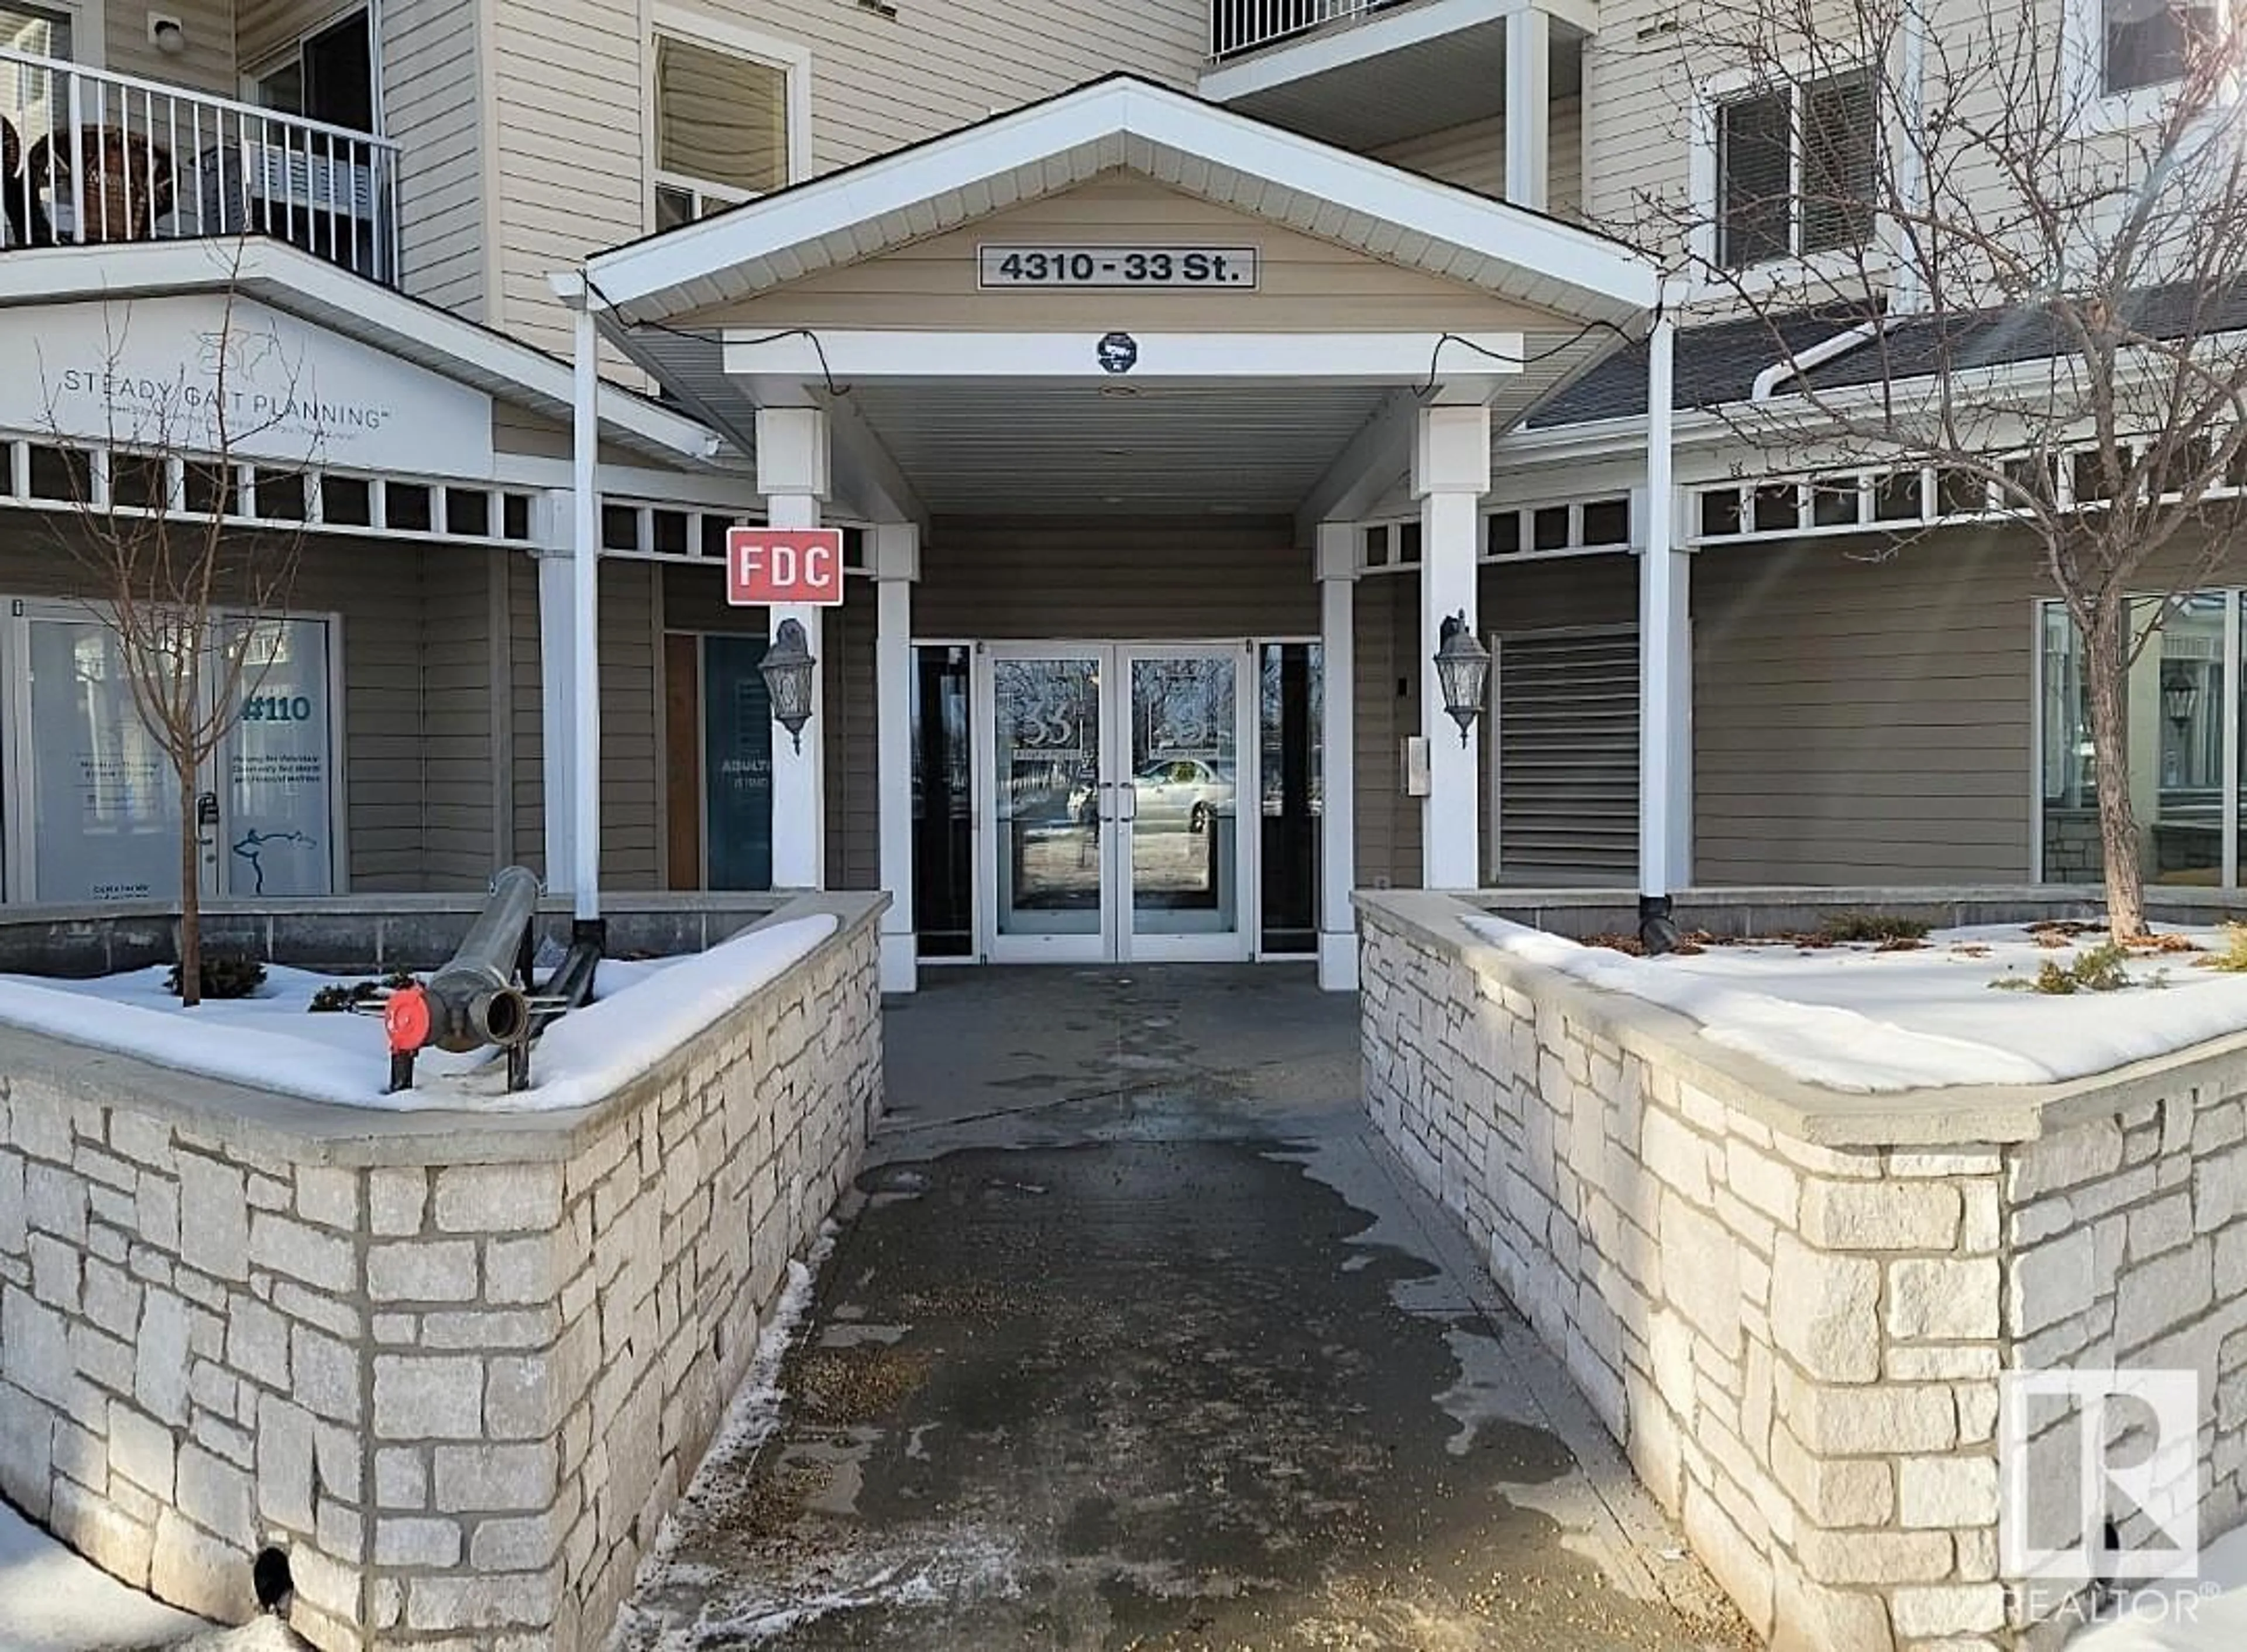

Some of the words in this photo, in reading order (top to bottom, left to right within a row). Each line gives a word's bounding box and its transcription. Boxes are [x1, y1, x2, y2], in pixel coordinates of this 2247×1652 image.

[1182, 253, 1239, 281] St.
[64, 369, 172, 402] STEADY
[184, 386, 244, 411] GAIT
[740, 546, 830, 588] FDC
[241, 696, 311, 721] #110
